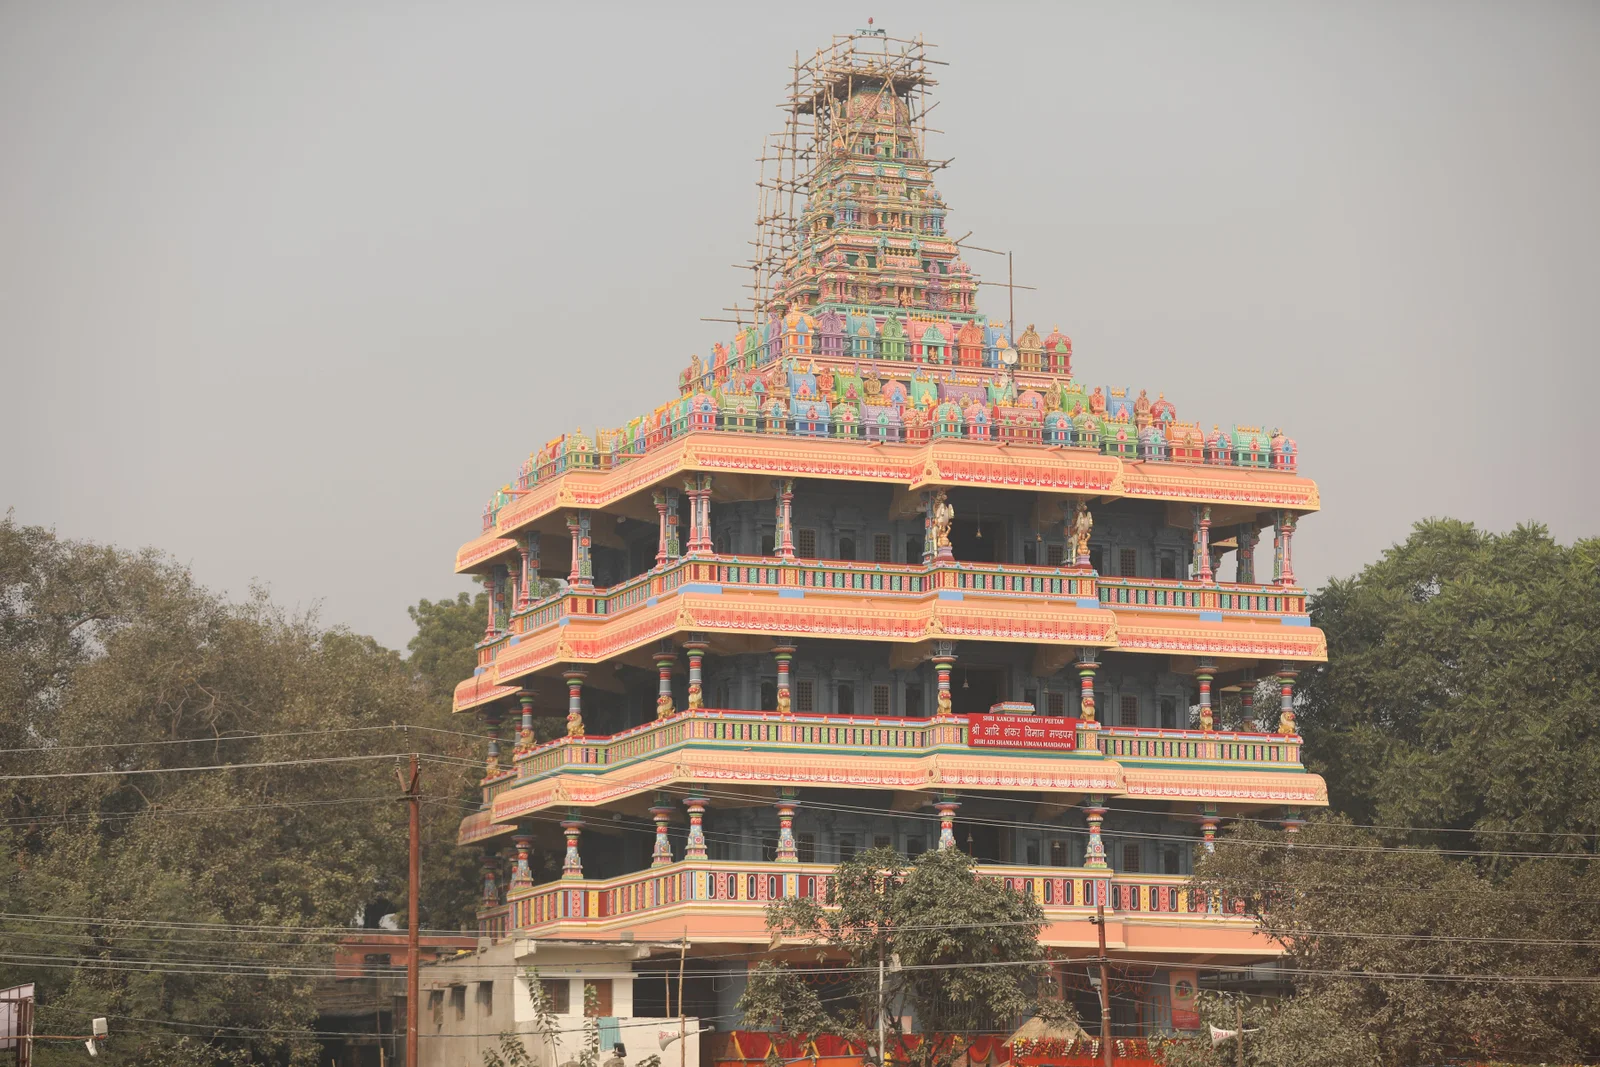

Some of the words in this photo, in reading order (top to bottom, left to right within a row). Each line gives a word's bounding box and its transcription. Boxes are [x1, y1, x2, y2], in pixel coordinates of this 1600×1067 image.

[971, 723, 980, 736] श्री
[984, 724, 1000, 737] आदि
[1004, 725, 1021, 738] शंकर
[1024, 725, 1045, 738] विमान
[1049, 729, 1074, 741] मण्डपम्
